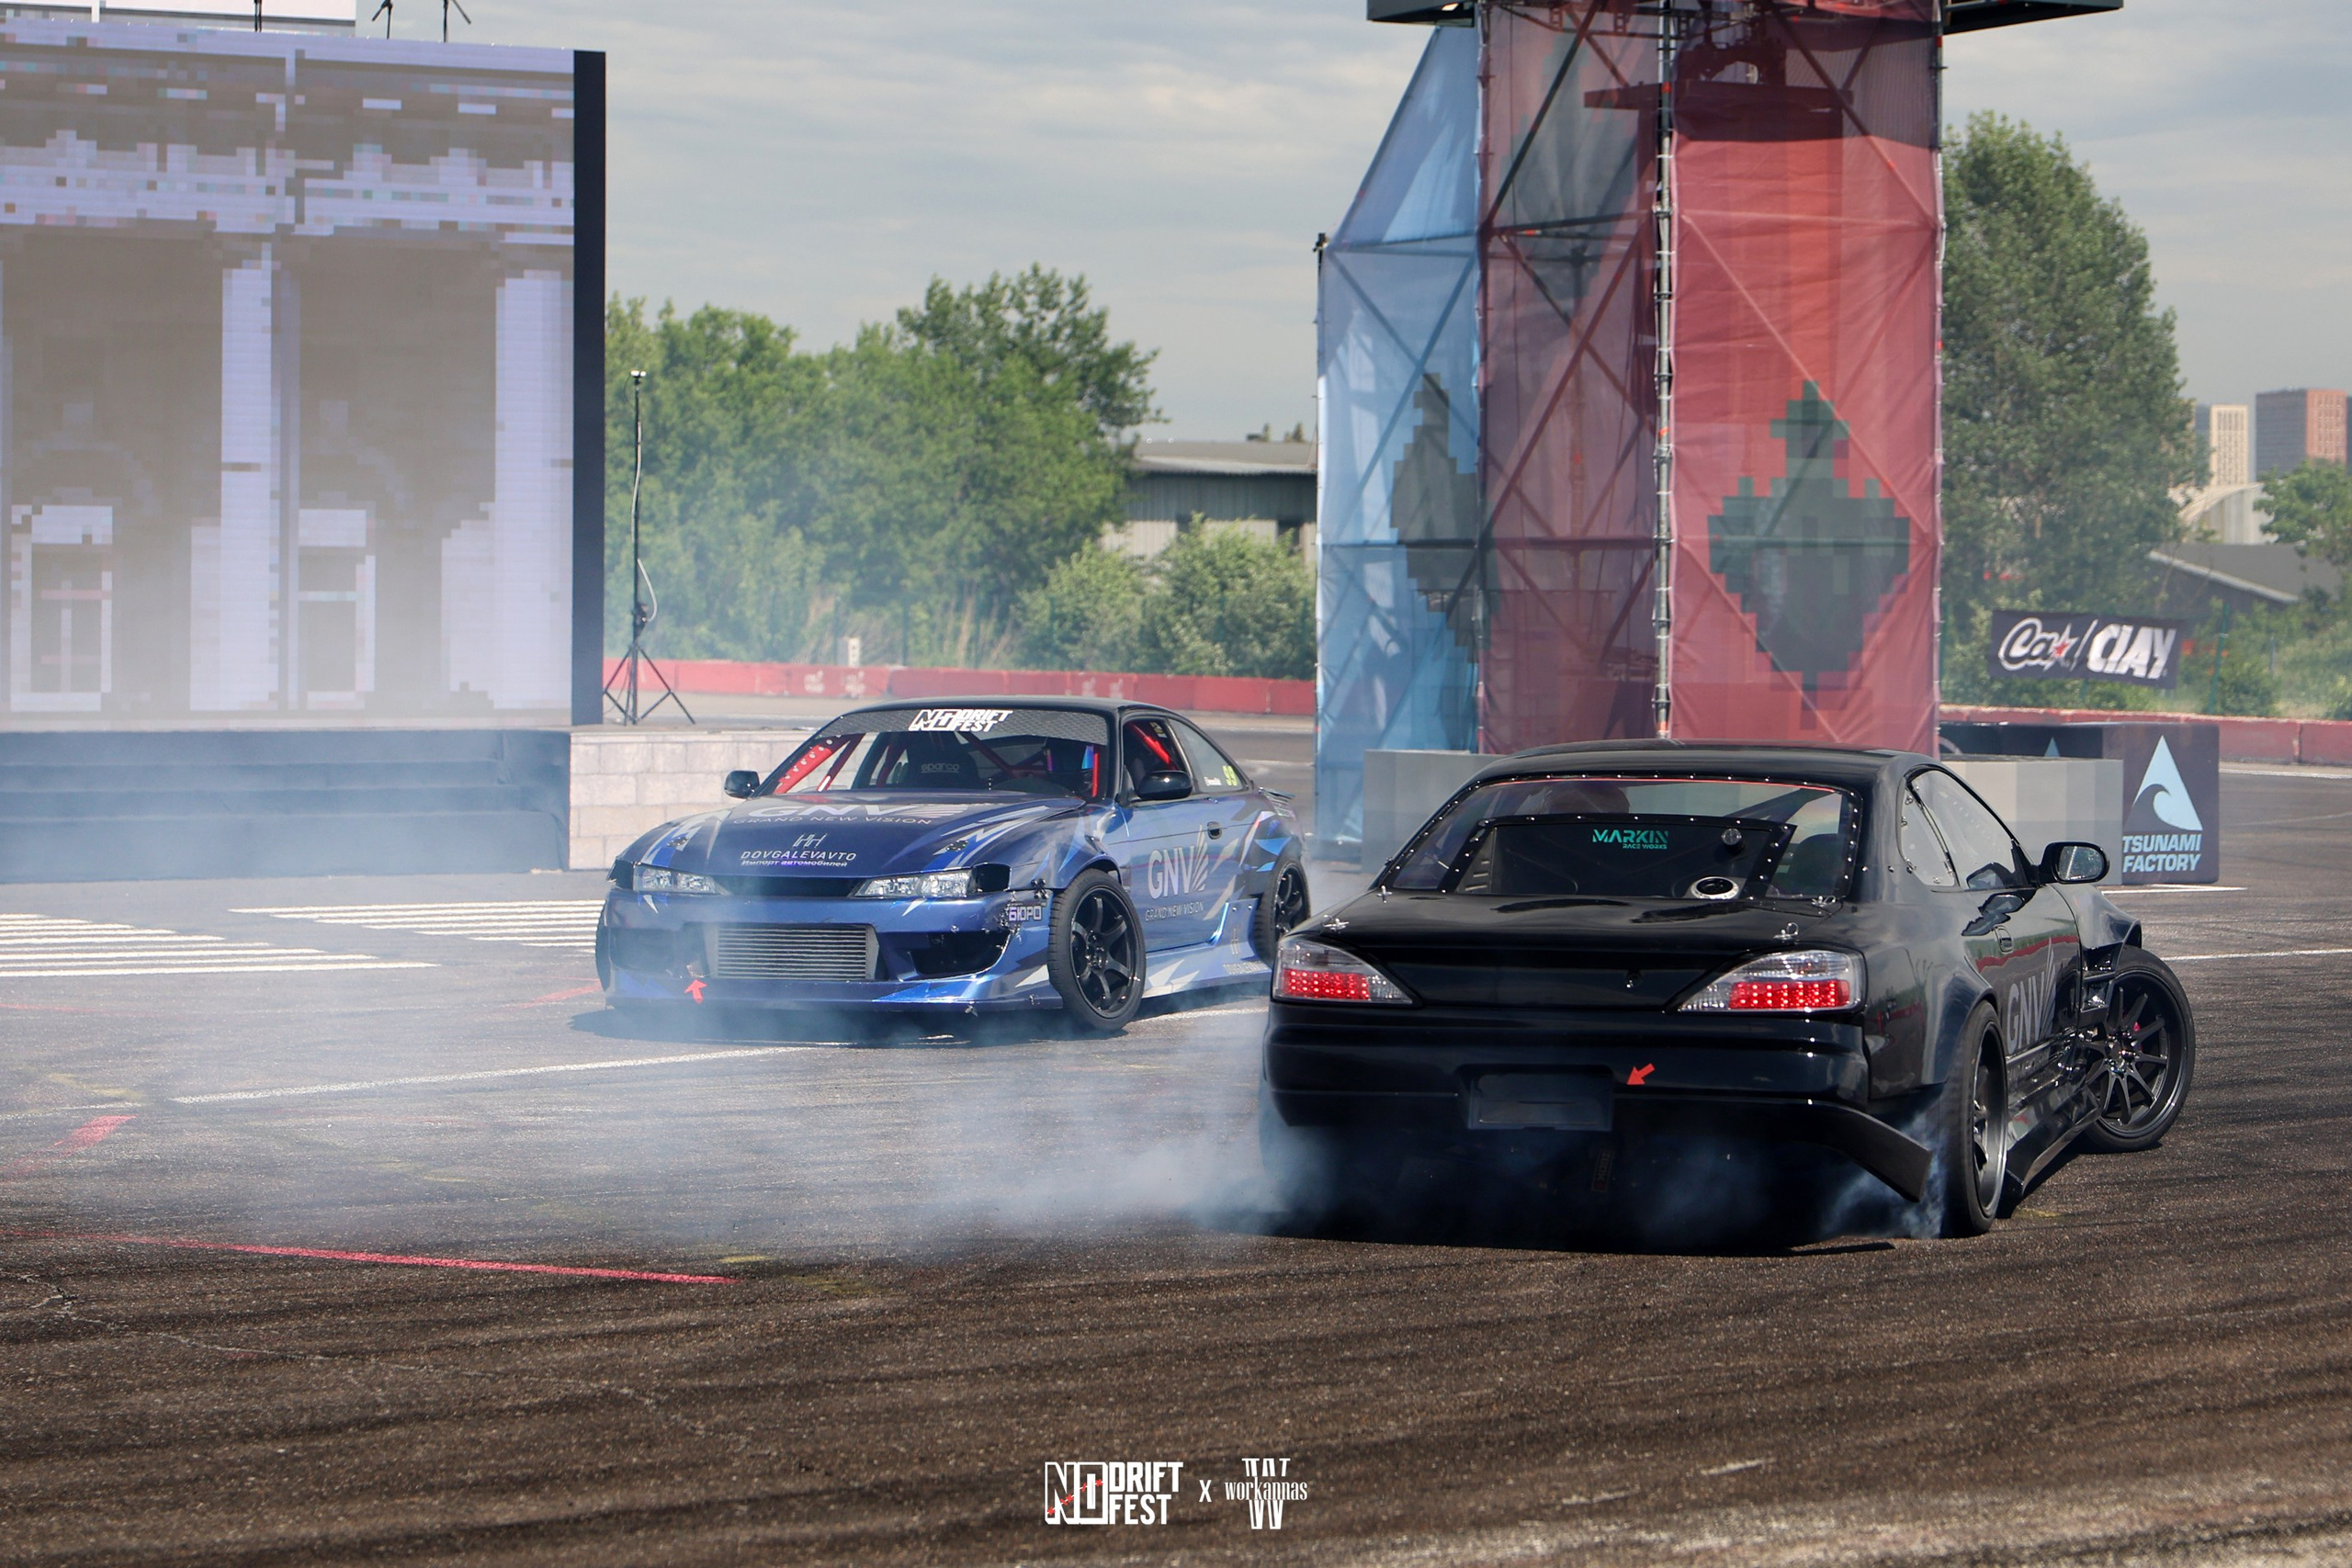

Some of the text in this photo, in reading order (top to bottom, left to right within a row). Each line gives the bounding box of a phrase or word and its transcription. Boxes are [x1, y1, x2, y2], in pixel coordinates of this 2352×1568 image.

[956, 709, 1013, 722] DRIFT
[954, 720, 998, 732] FEST
[922, 763, 959, 773] sparco
[865, 816, 932, 825] VISION
[1592, 829, 1668, 843] MARKIN
[2122, 834, 2202, 852] TSUNAMI
[741, 851, 857, 862] DOVGALEVAVTO
[2122, 854, 2201, 873] FACTORY
[1148, 844, 1195, 899] GNV
[1009, 905, 1042, 921] БЮРО
[1145, 900, 1204, 922] GRAND NEW VISION
[2007, 970, 2046, 1055] GNV
